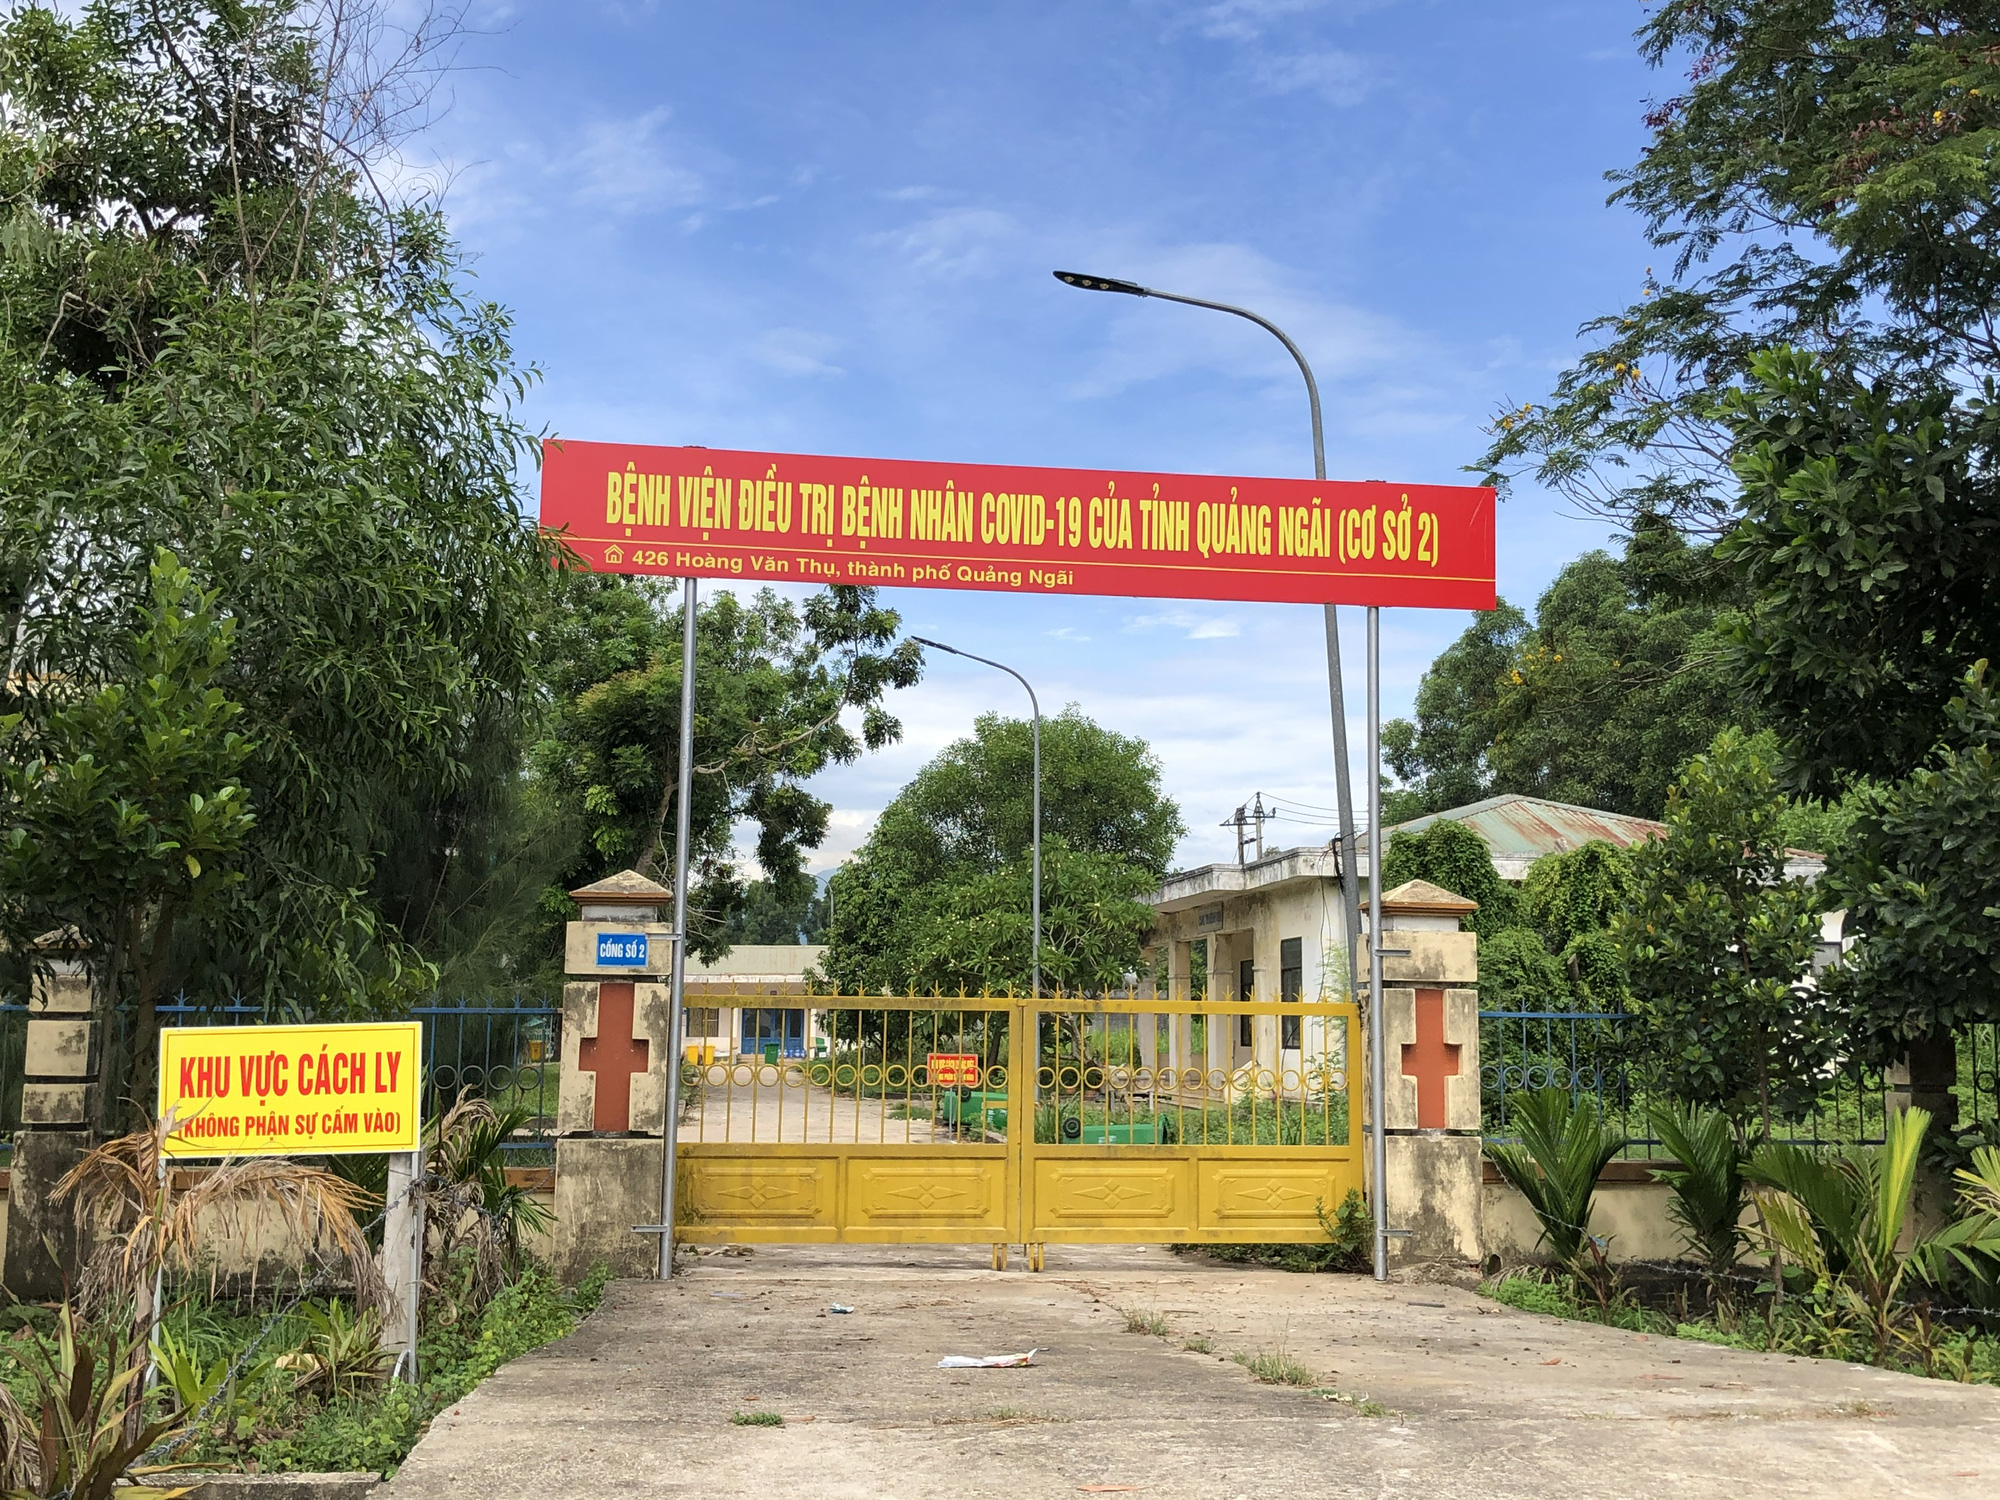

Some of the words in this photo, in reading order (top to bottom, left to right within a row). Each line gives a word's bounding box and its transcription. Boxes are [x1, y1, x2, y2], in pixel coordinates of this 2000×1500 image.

[606, 461, 672, 537] BỆNH
[678, 465, 732, 541] VIỆN
[738, 463, 793, 534] ĐIỀU
[799, 482, 835, 548] TRỊ
[841, 475, 904, 550] BỆNH
[909, 479, 974, 543] NHÂN
[980, 492, 1082, 548] COVID-19
[1088, 480, 1133, 550] CỦA
[1139, 482, 1190, 552] TỈNH
[1196, 486, 1272, 559] QUẢNG
[1278, 497, 1331, 558] NGÃI
[1338, 504, 1377, 565] (CƠ
[1382, 493, 1412, 561] SỞ
[1417, 512, 1439, 568] 2)
[632, 550, 669, 567] 426
[676, 551, 743, 574] Hoàng
[750, 555, 789, 573] Văn
[795, 557, 841, 579] Thụ,
[847, 559, 905, 578] thành
[912, 562, 951, 583] phố
[956, 565, 1022, 587] Quảng
[1029, 569, 1073, 589] Ngãi
[625, 939, 638, 958] SỐ
[638, 944, 645, 958] 2
[179, 1056, 231, 1099] KHU
[239, 1050, 289, 1107] VỰC
[297, 1043, 366, 1096] CÁCH
[374, 1051, 402, 1094] LY
[245, 1110, 290, 1141] PHẬN
[294, 1112, 319, 1139] SỰ
[321, 1105, 359, 1135] CẤM
[363, 1107, 401, 1135] VÀO)
